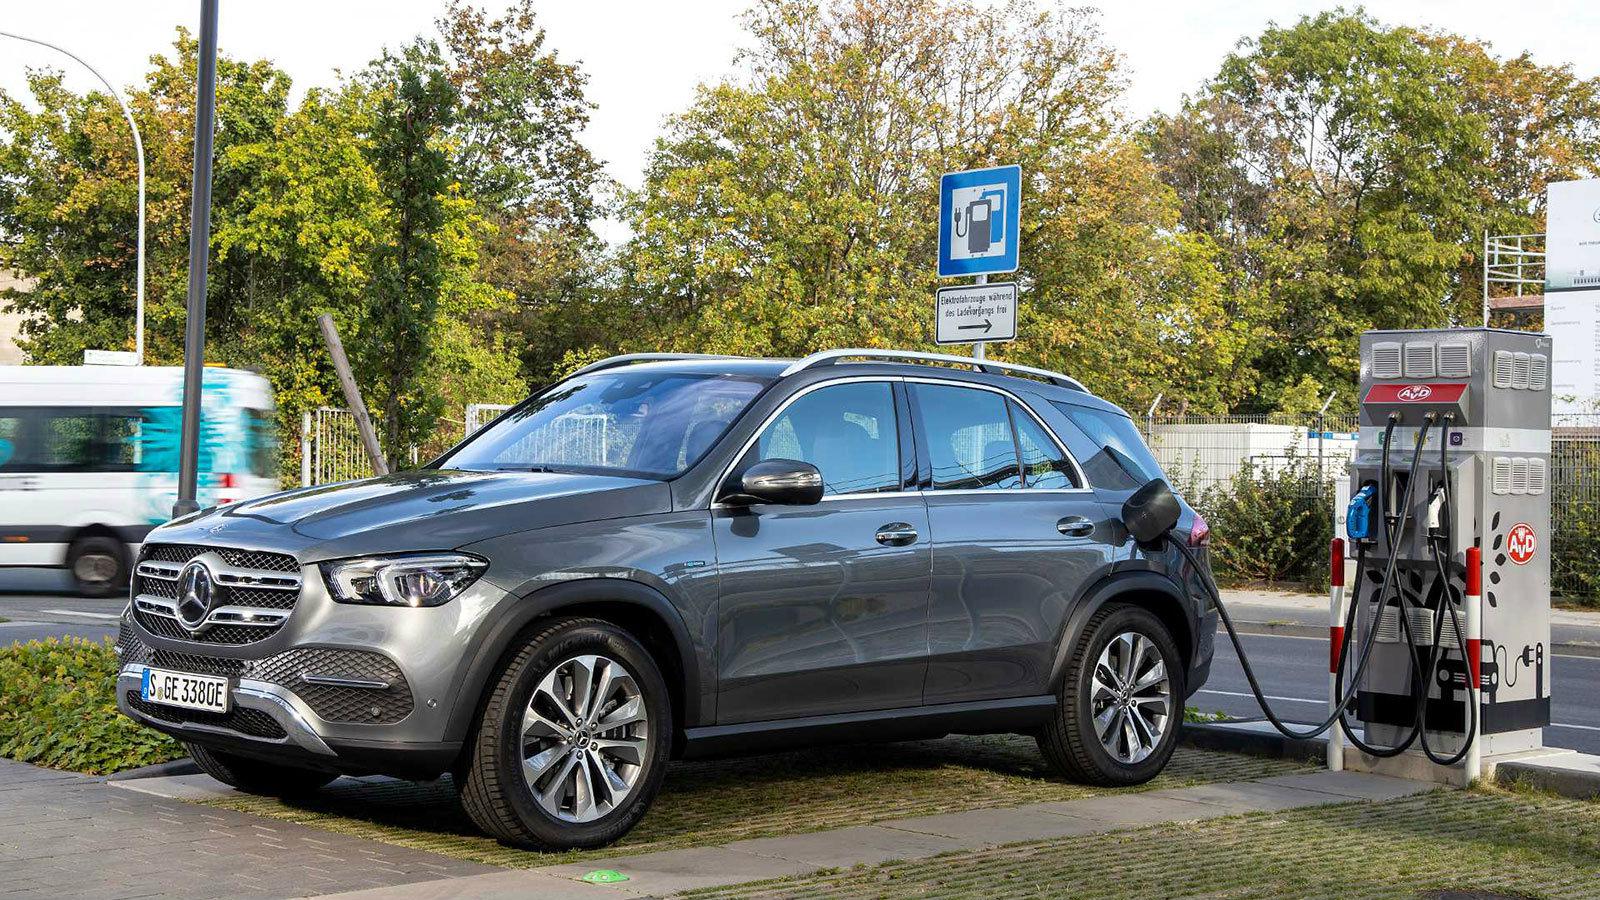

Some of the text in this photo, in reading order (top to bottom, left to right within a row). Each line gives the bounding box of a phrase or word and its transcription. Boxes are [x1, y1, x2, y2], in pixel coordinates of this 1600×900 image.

[941, 292, 1012, 305] Elektrofahrzeuge während
[945, 305, 1007, 317] des Ladevorgangs frei
[149, 673, 157, 697] S
